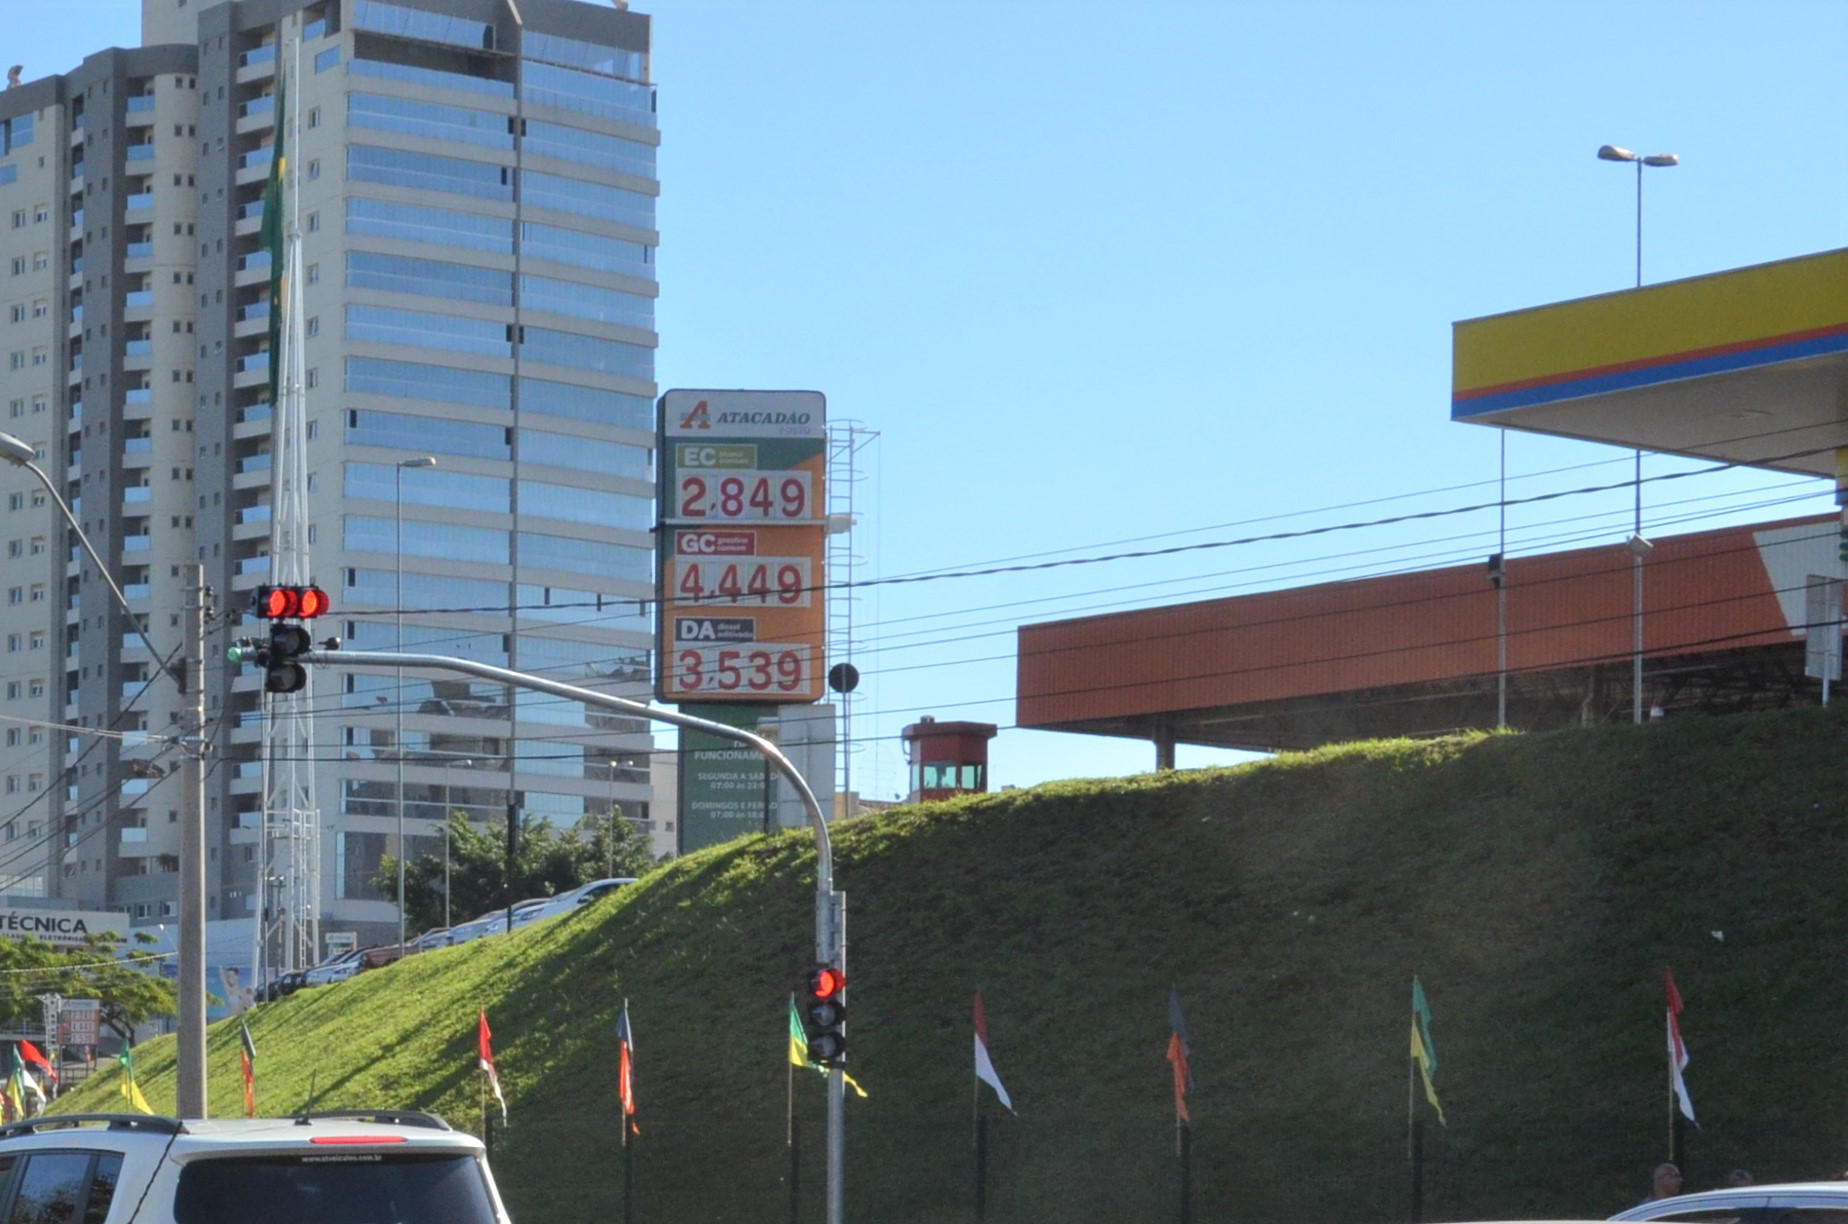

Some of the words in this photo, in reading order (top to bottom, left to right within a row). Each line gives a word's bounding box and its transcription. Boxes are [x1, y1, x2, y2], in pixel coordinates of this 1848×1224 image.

[717, 411, 811, 425] ATACADÃO
[684, 447, 716, 466] EC
[681, 477, 806, 518] 2,849
[681, 533, 716, 553] GC
[680, 563, 802, 604] 4,449
[681, 620, 716, 640] DA
[679, 649, 802, 692] 3,539
